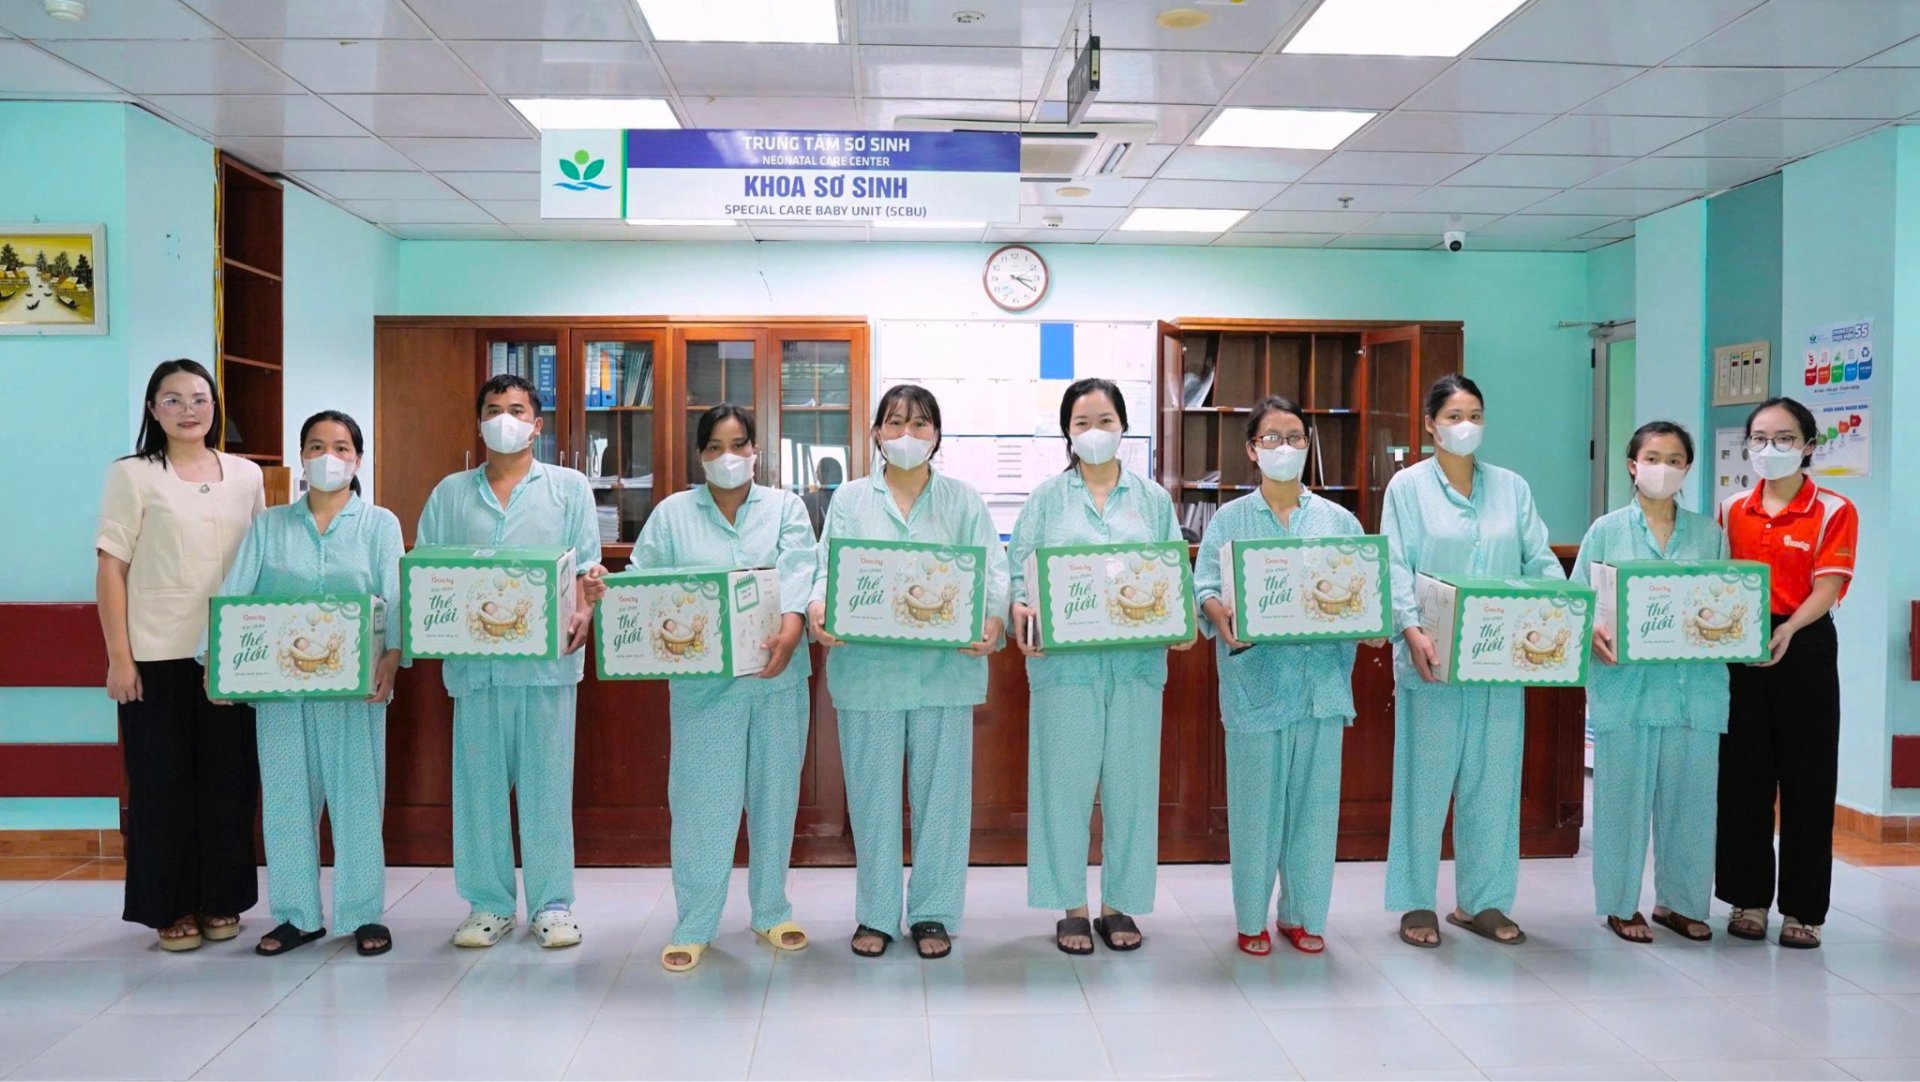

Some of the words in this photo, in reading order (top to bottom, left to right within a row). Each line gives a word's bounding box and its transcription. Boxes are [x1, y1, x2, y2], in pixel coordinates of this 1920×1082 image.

[742, 136, 800, 151] TRUNG
[804, 134, 840, 151] TÂM
[844, 135, 866, 152] SƠ
[870, 137, 911, 153] SINH
[762, 155, 817, 166] NEONATAL
[819, 155, 847, 166] CARE
[849, 156, 890, 167] CENTER
[744, 175, 806, 198] KHOA
[813, 174, 845, 198] SƠ
[852, 176, 908, 199] SINH
[724, 204, 776, 215] SPECIAL
[779, 205, 812, 215] CARE
[815, 205, 848, 216] BABY
[851, 206, 882, 216] UNIT
[885, 206, 927, 218] (SCBU)
[1855, 323, 1869, 339] 5S
[856, 575, 884, 591] thế
[1068, 579, 1094, 598] thế
[1263, 573, 1290, 591] thế
[429, 593, 456, 610] thế
[849, 589, 885, 613] giới
[1064, 594, 1099, 620] giới
[1258, 587, 1296, 614] giới
[1646, 600, 1673, 617] thế
[423, 607, 459, 632] giới
[616, 612, 640, 630] thế
[1640, 614, 1676, 639] giới
[239, 630, 268, 648] thế
[613, 626, 644, 653] giới
[1479, 622, 1505, 639] thế
[1471, 636, 1506, 660] giới
[232, 645, 270, 671] giới
